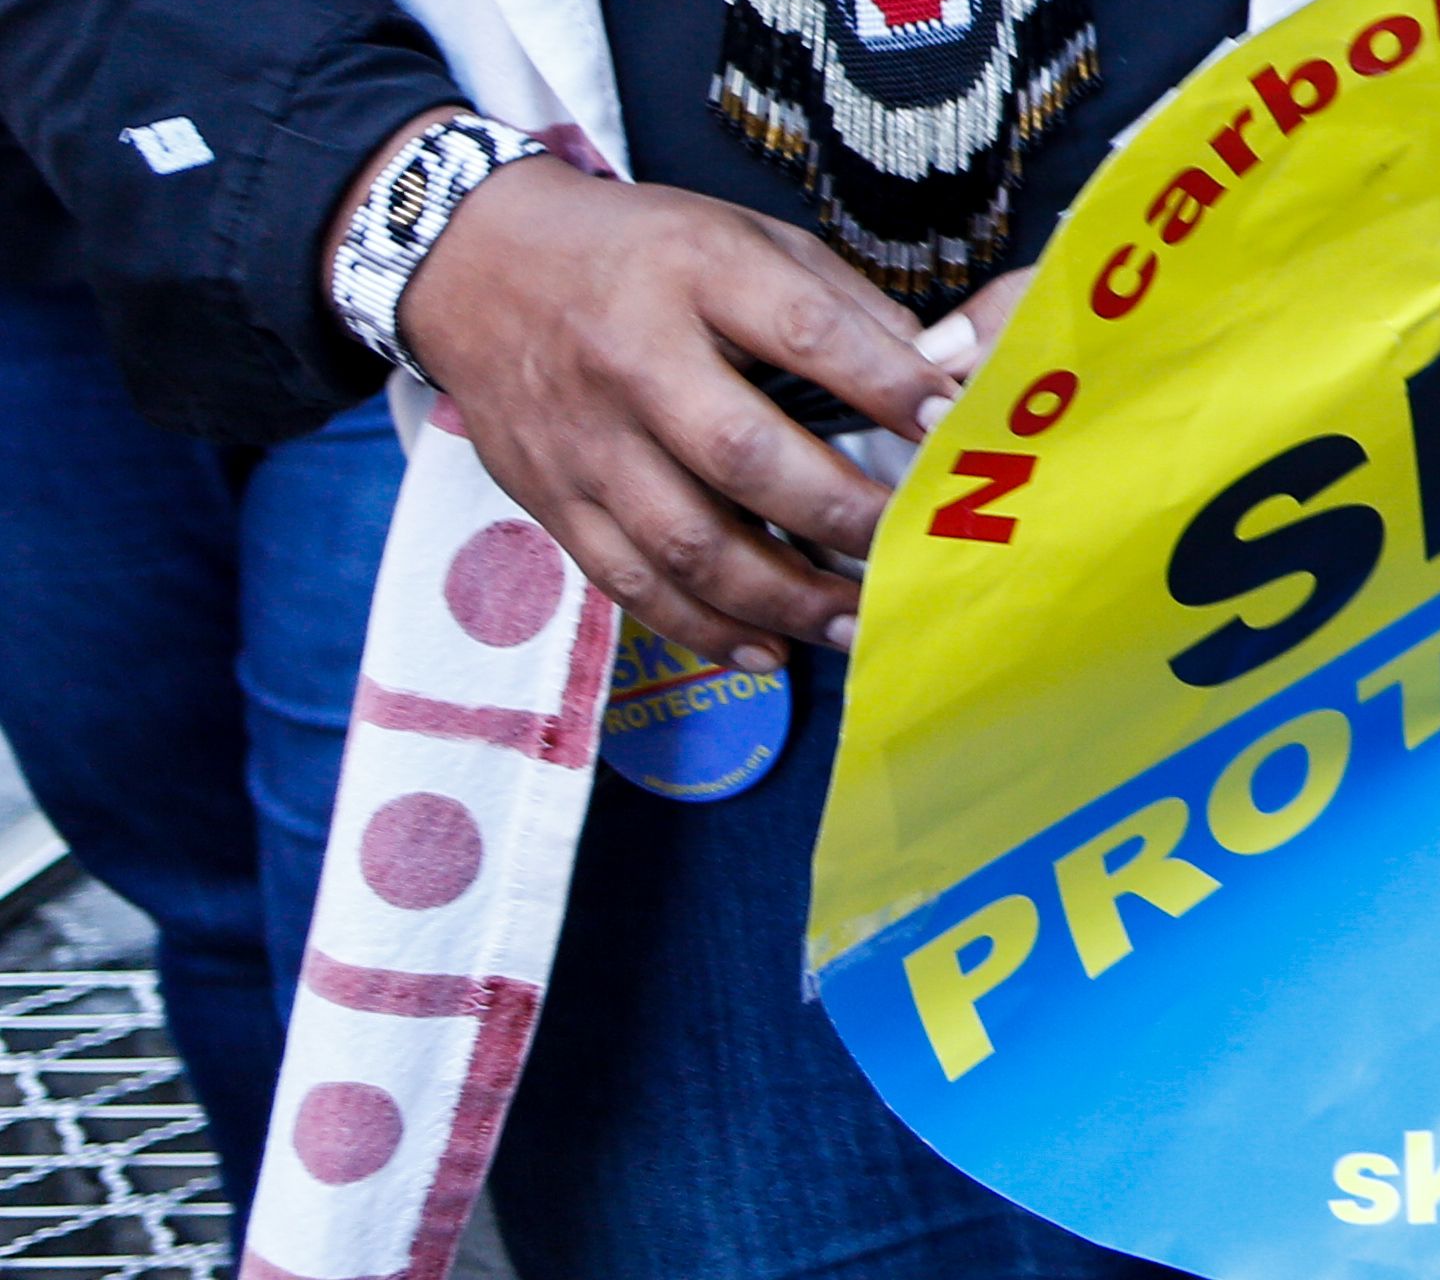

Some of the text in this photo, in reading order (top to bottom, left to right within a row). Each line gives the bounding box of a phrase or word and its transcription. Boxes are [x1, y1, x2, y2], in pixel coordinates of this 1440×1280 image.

[927, 370, 1078, 545] No
[611, 632, 713, 689] SK
[608, 673, 781, 733] ROTECTOR
